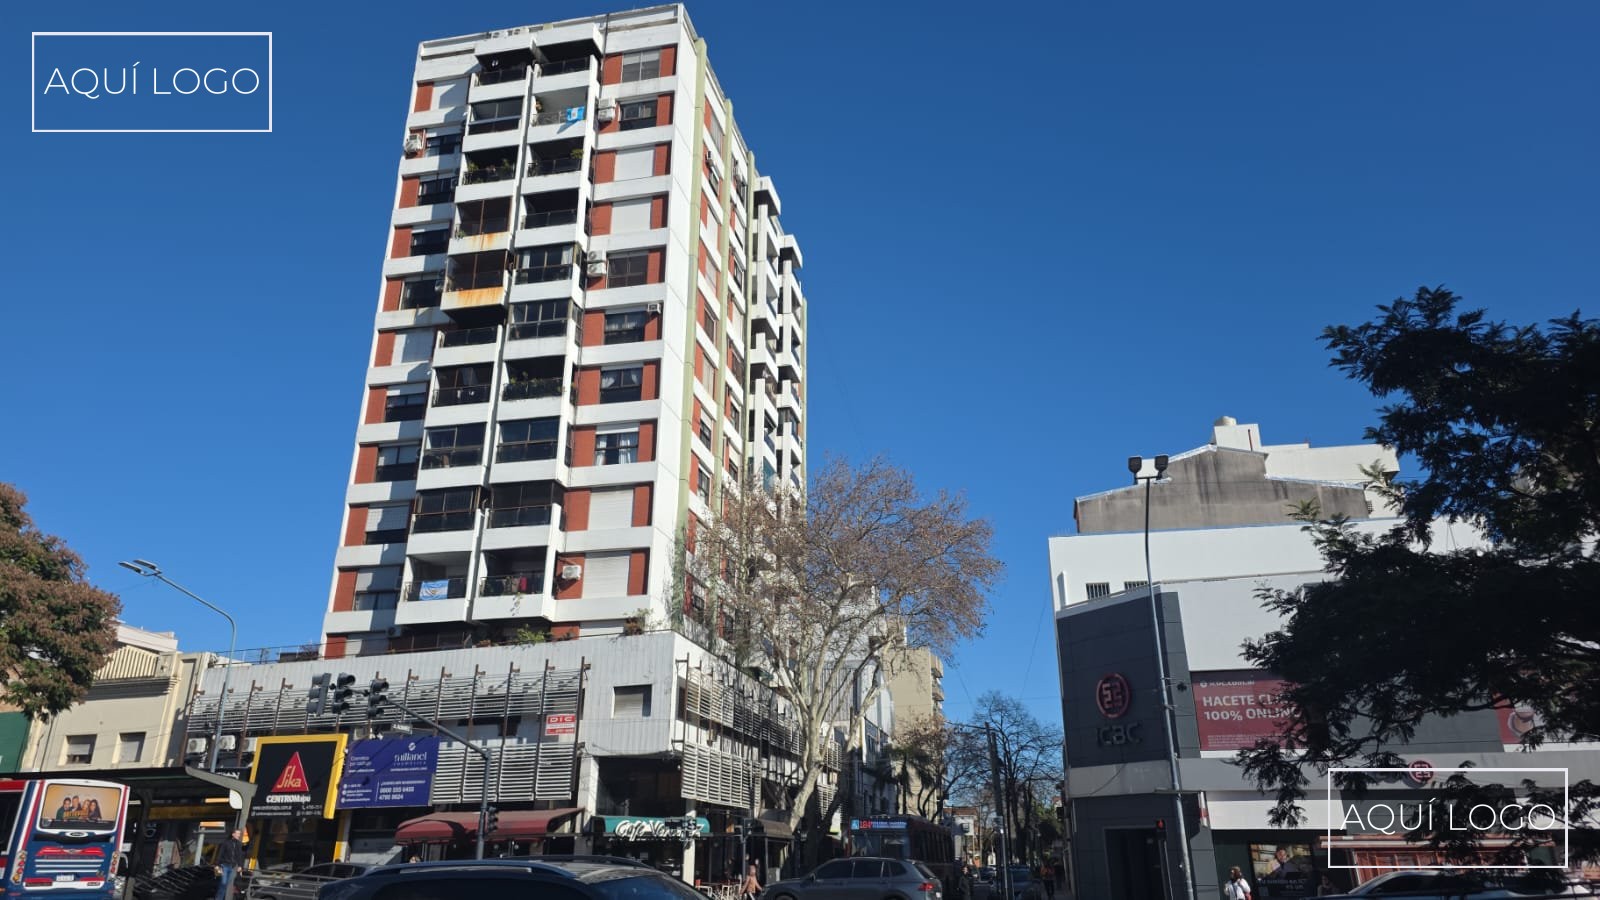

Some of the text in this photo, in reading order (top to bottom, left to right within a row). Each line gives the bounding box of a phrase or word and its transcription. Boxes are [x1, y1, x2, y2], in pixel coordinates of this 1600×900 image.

[1202, 695, 1256, 707] HACETE
[1204, 710, 1243, 721] 100%
[276, 765, 302, 788] Sika
